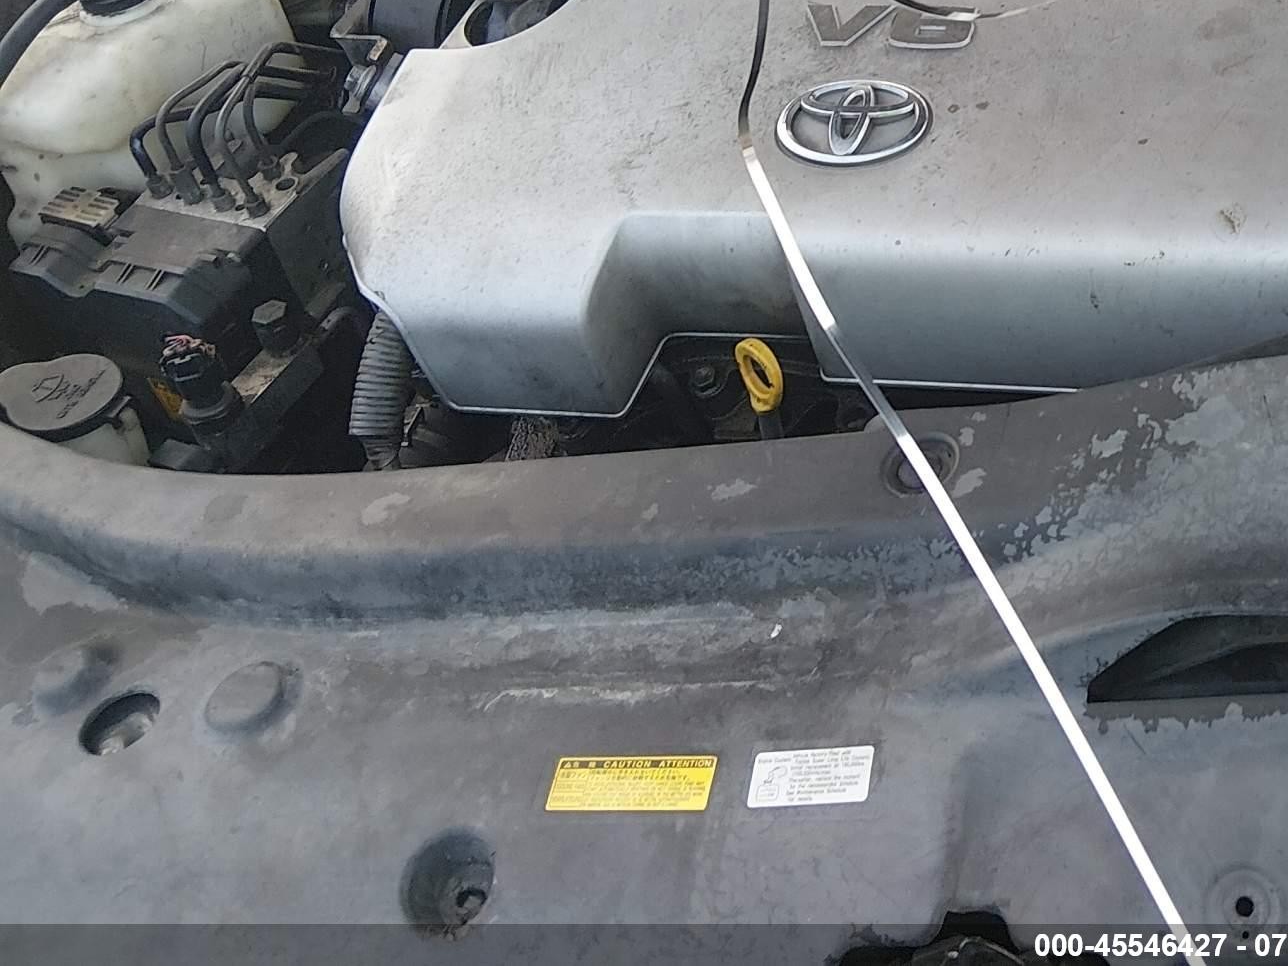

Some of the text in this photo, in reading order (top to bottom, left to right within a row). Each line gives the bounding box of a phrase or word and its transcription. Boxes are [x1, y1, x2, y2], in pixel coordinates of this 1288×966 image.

[807, 5, 977, 50] V6
[603, 760, 652, 768] CAUTION
[659, 759, 713, 768] ATTENTION
